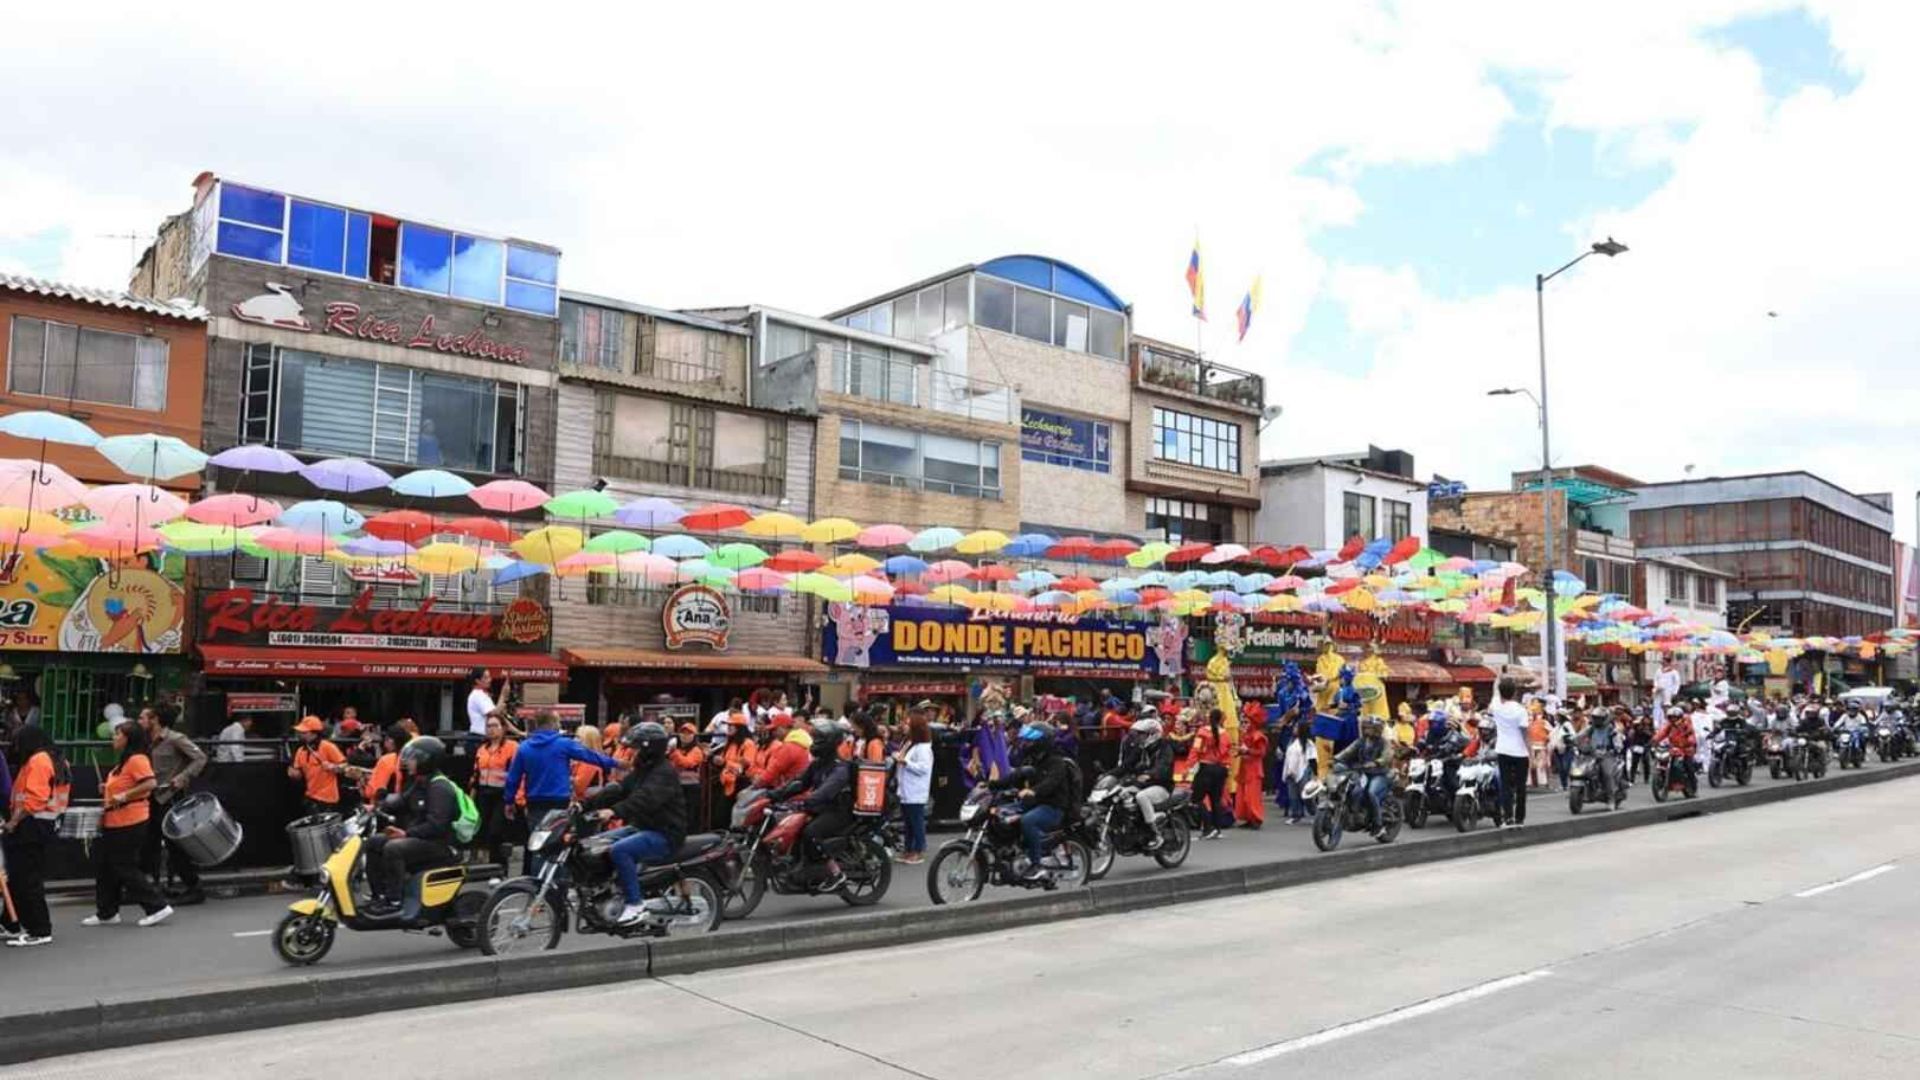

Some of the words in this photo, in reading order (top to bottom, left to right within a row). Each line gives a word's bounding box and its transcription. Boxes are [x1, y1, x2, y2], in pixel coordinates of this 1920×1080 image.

[325, 302, 400, 342] Rica
[409, 314, 532, 363] Lechona
[203, 586, 319, 638] Rica
[328, 585, 493, 637] Lechona
[684, 609, 710, 623] Ana
[13, 631, 48, 645] Sur
[893, 619, 1007, 656] DONDE
[1013, 626, 1145, 661] PACHECO
[1246, 626, 1285, 647] Festival
